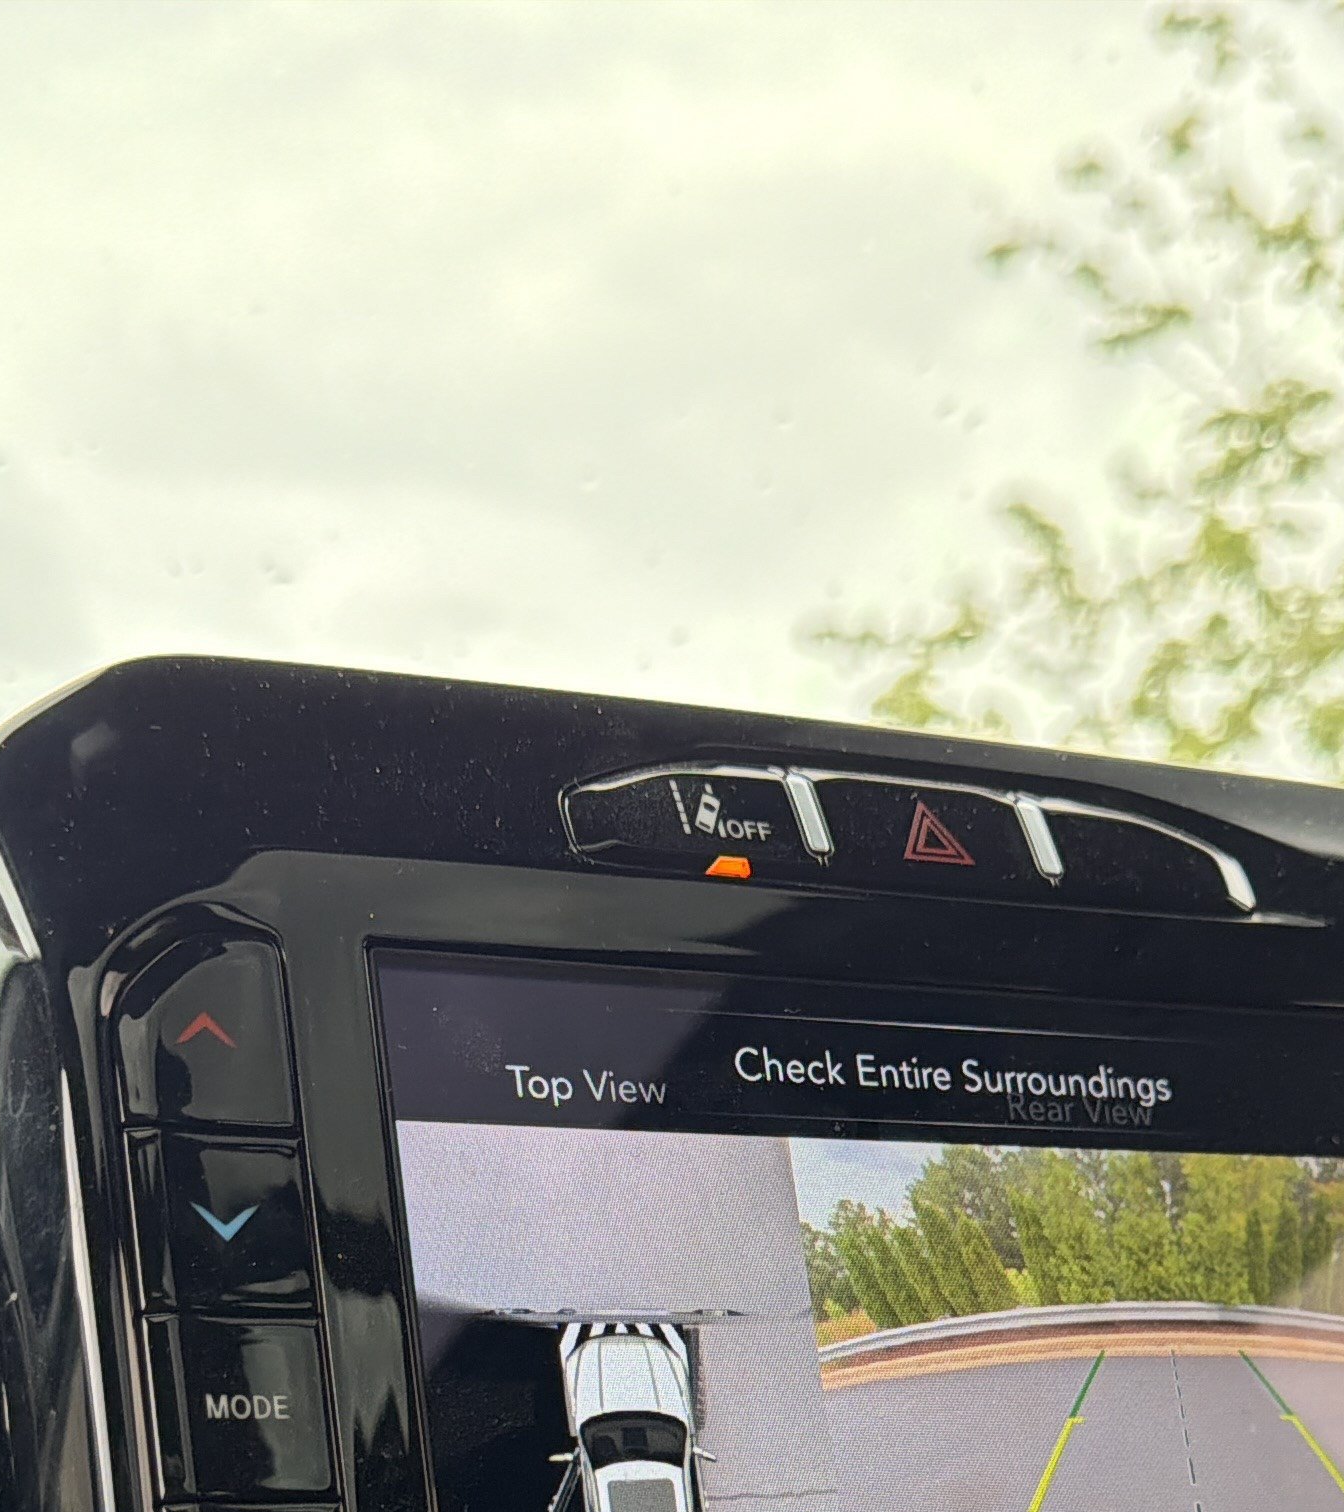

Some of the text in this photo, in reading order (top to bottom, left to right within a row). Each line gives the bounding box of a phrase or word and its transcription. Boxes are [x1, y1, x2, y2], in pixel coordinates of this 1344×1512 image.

[726, 818, 771, 842] OFF
[506, 1067, 666, 1106] Top View
[734, 1047, 1172, 1105] Check Entire Surroundings
[1008, 1092, 1153, 1127] Rear View
[206, 1394, 290, 1420] MODE
